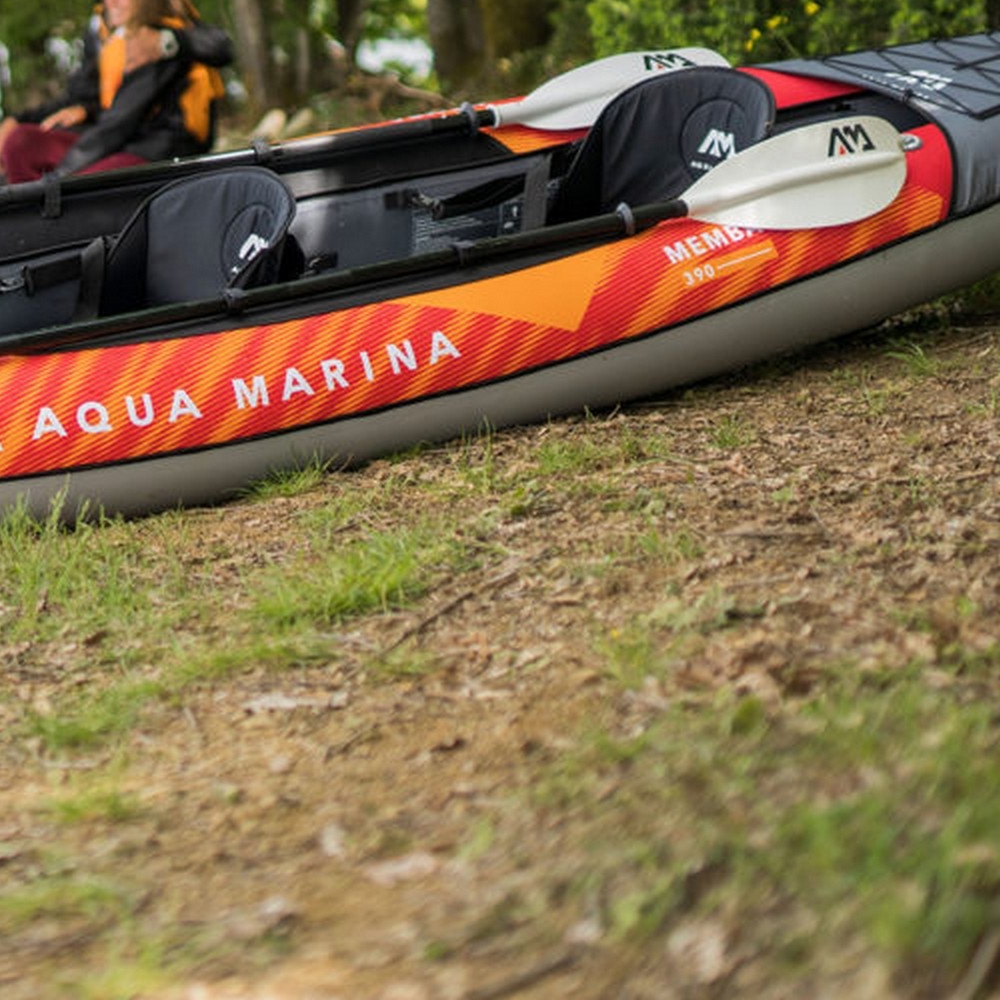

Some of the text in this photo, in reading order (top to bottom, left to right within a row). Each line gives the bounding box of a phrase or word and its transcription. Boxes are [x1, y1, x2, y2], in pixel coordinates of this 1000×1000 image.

[683, 264, 715, 286] 390
[32, 389, 203, 440] AQUA
[231, 331, 462, 409] MARINA
